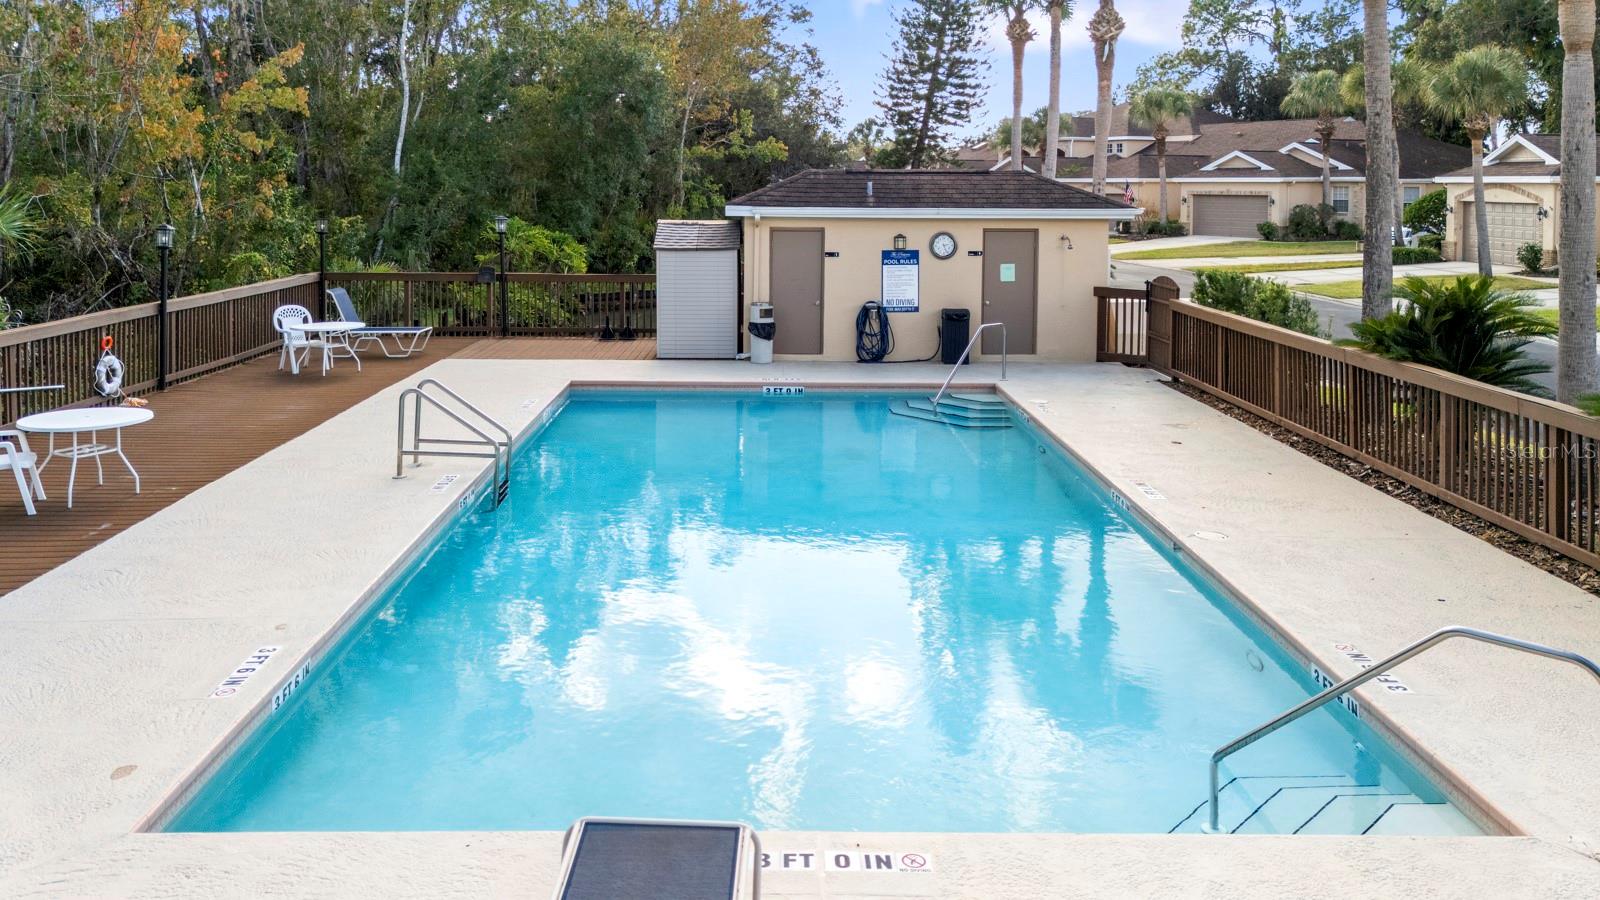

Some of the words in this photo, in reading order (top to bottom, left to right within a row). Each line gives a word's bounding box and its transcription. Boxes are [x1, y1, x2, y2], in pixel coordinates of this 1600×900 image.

[246, 655, 270, 664] FT
[1346, 653, 1372, 662] IN
[222, 677, 248, 686] IN
[274, 695, 280, 710] 3
[282, 682, 292, 702] FT
[294, 674, 300, 689] 6
[302, 662, 310, 680] IN
[1313, 669, 1320, 683] 3
[1347, 697, 1358, 717] IN
[783, 853, 815, 868] FT
[864, 854, 893, 870] IN
